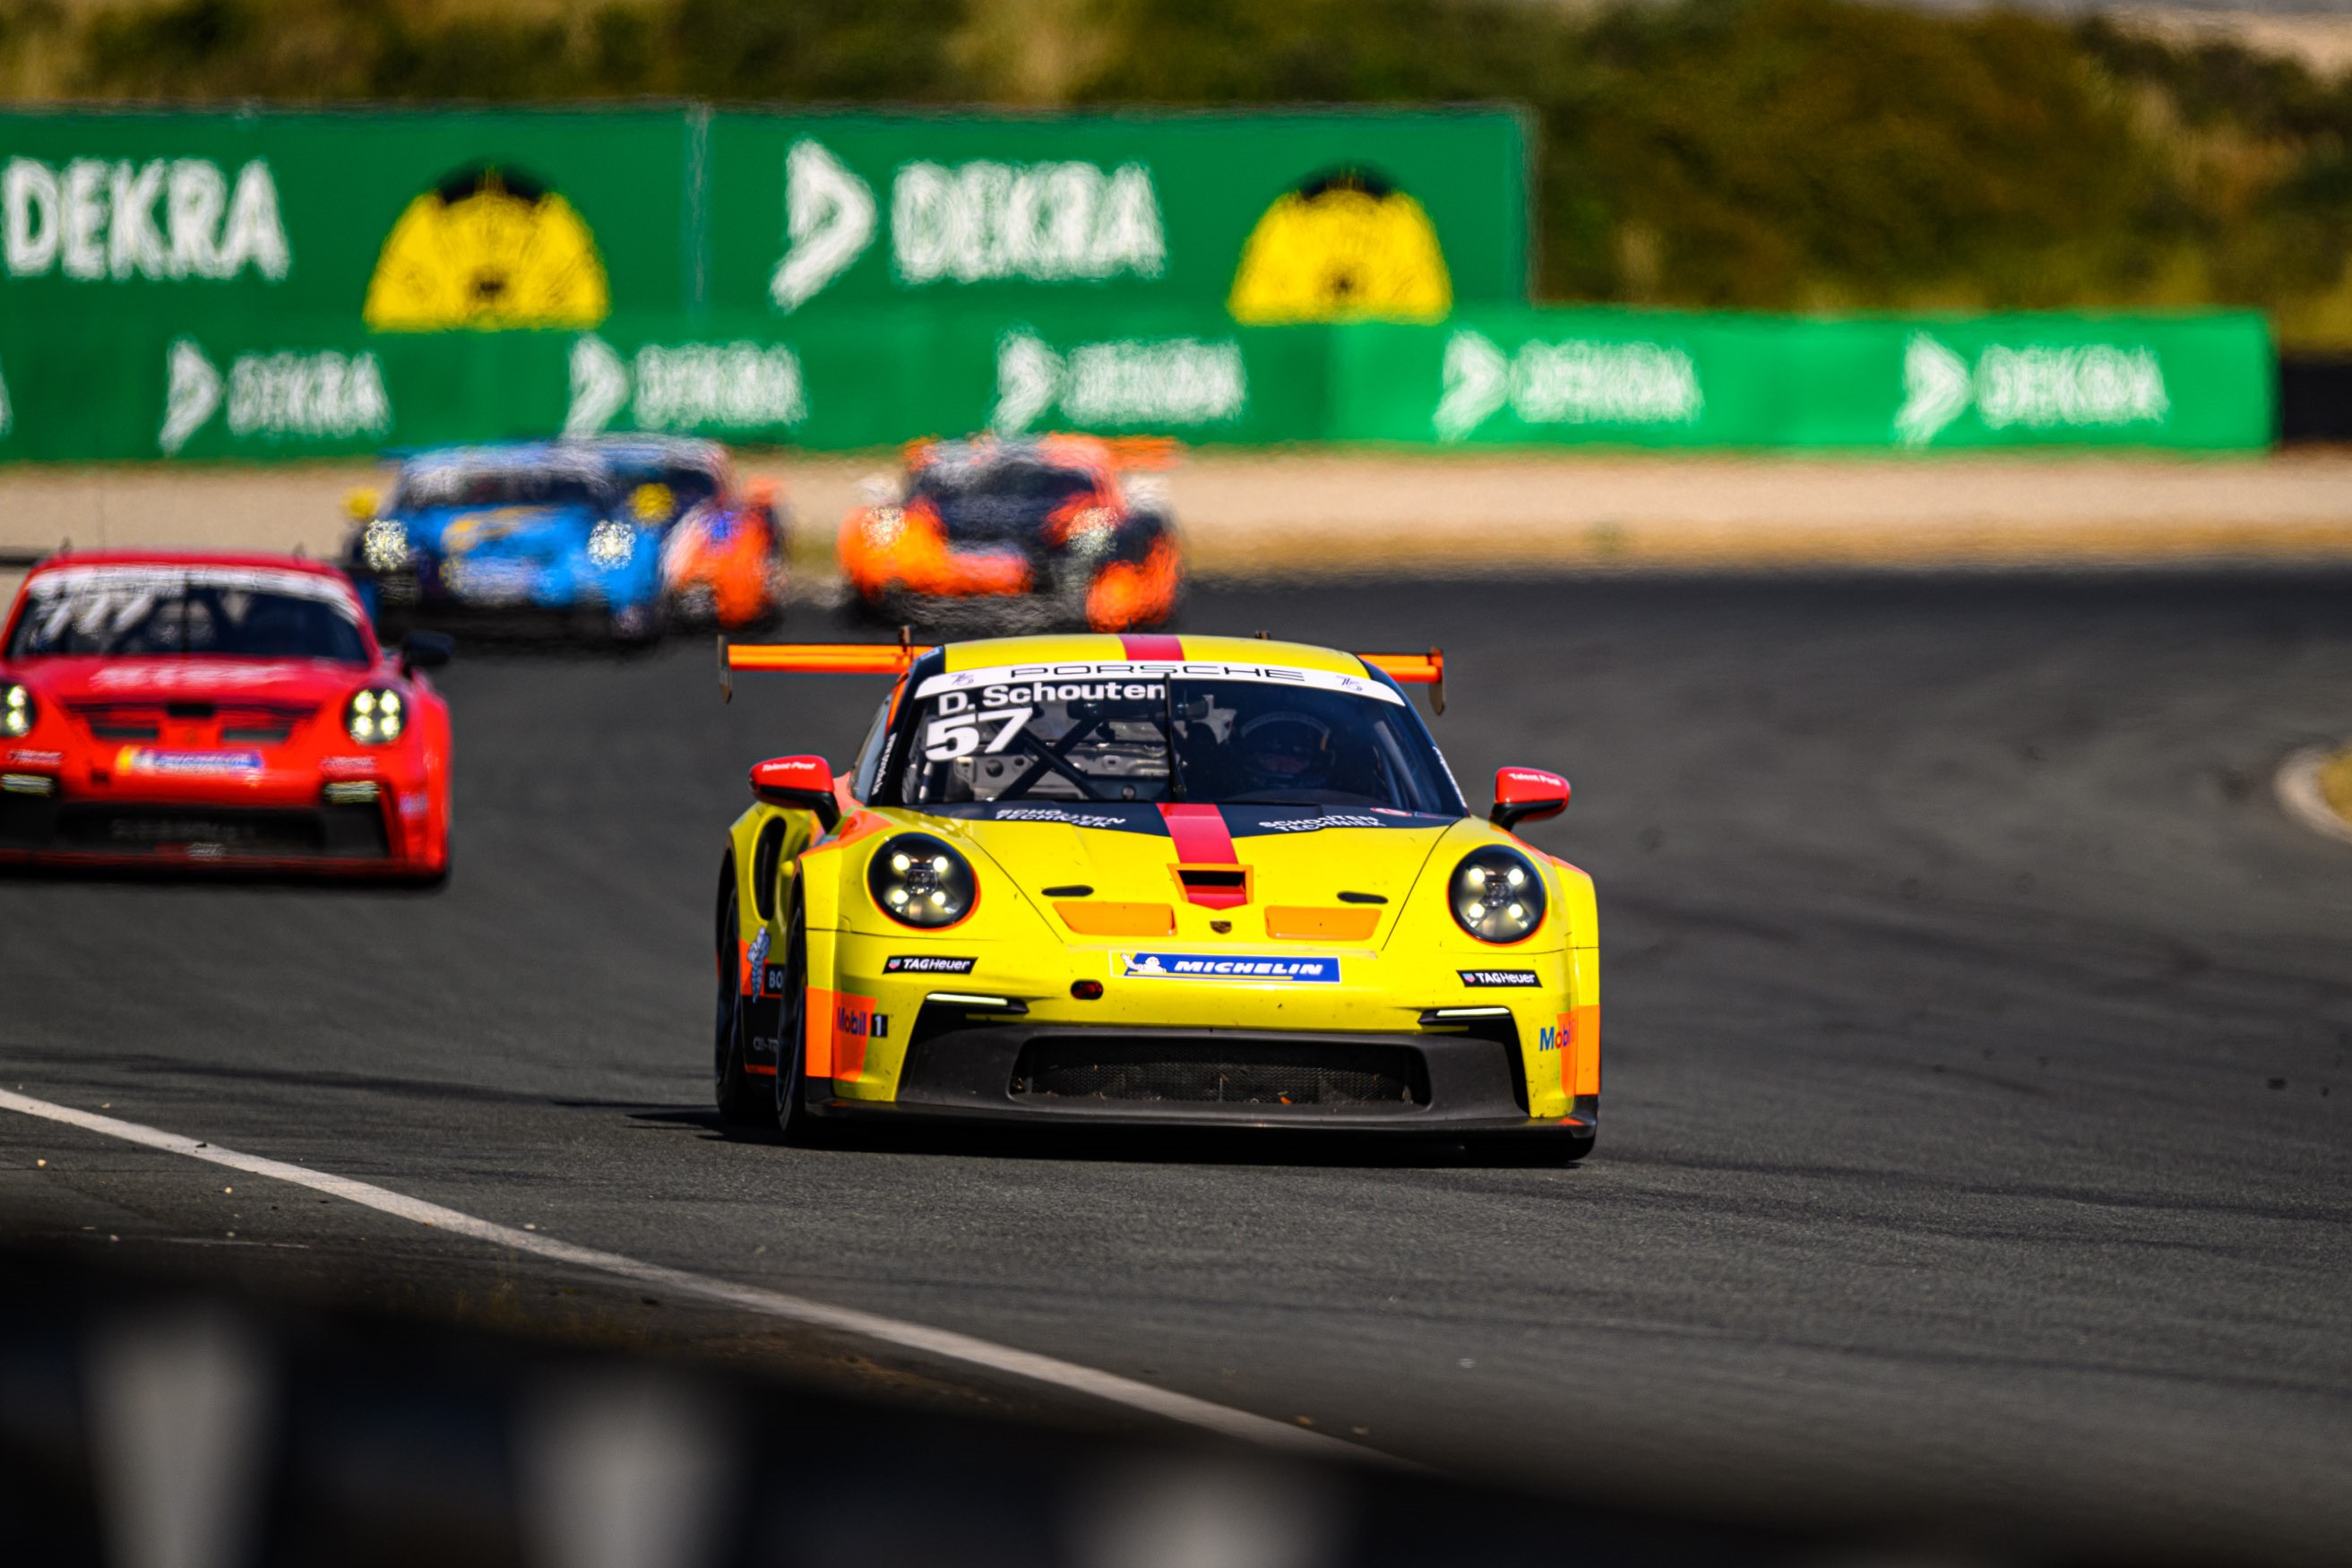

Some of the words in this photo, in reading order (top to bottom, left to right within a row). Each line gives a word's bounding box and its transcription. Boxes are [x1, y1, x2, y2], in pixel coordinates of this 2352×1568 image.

[4, 156, 291, 280] DEKRA
[1011, 664, 1305, 682] PORSCHE
[938, 692, 976, 717] D.
[982, 682, 1165, 708] Schouten
[925, 707, 1033, 762] 57
[1174, 961, 1324, 975] MICHELIN
[837, 1007, 866, 1037] Mobil
